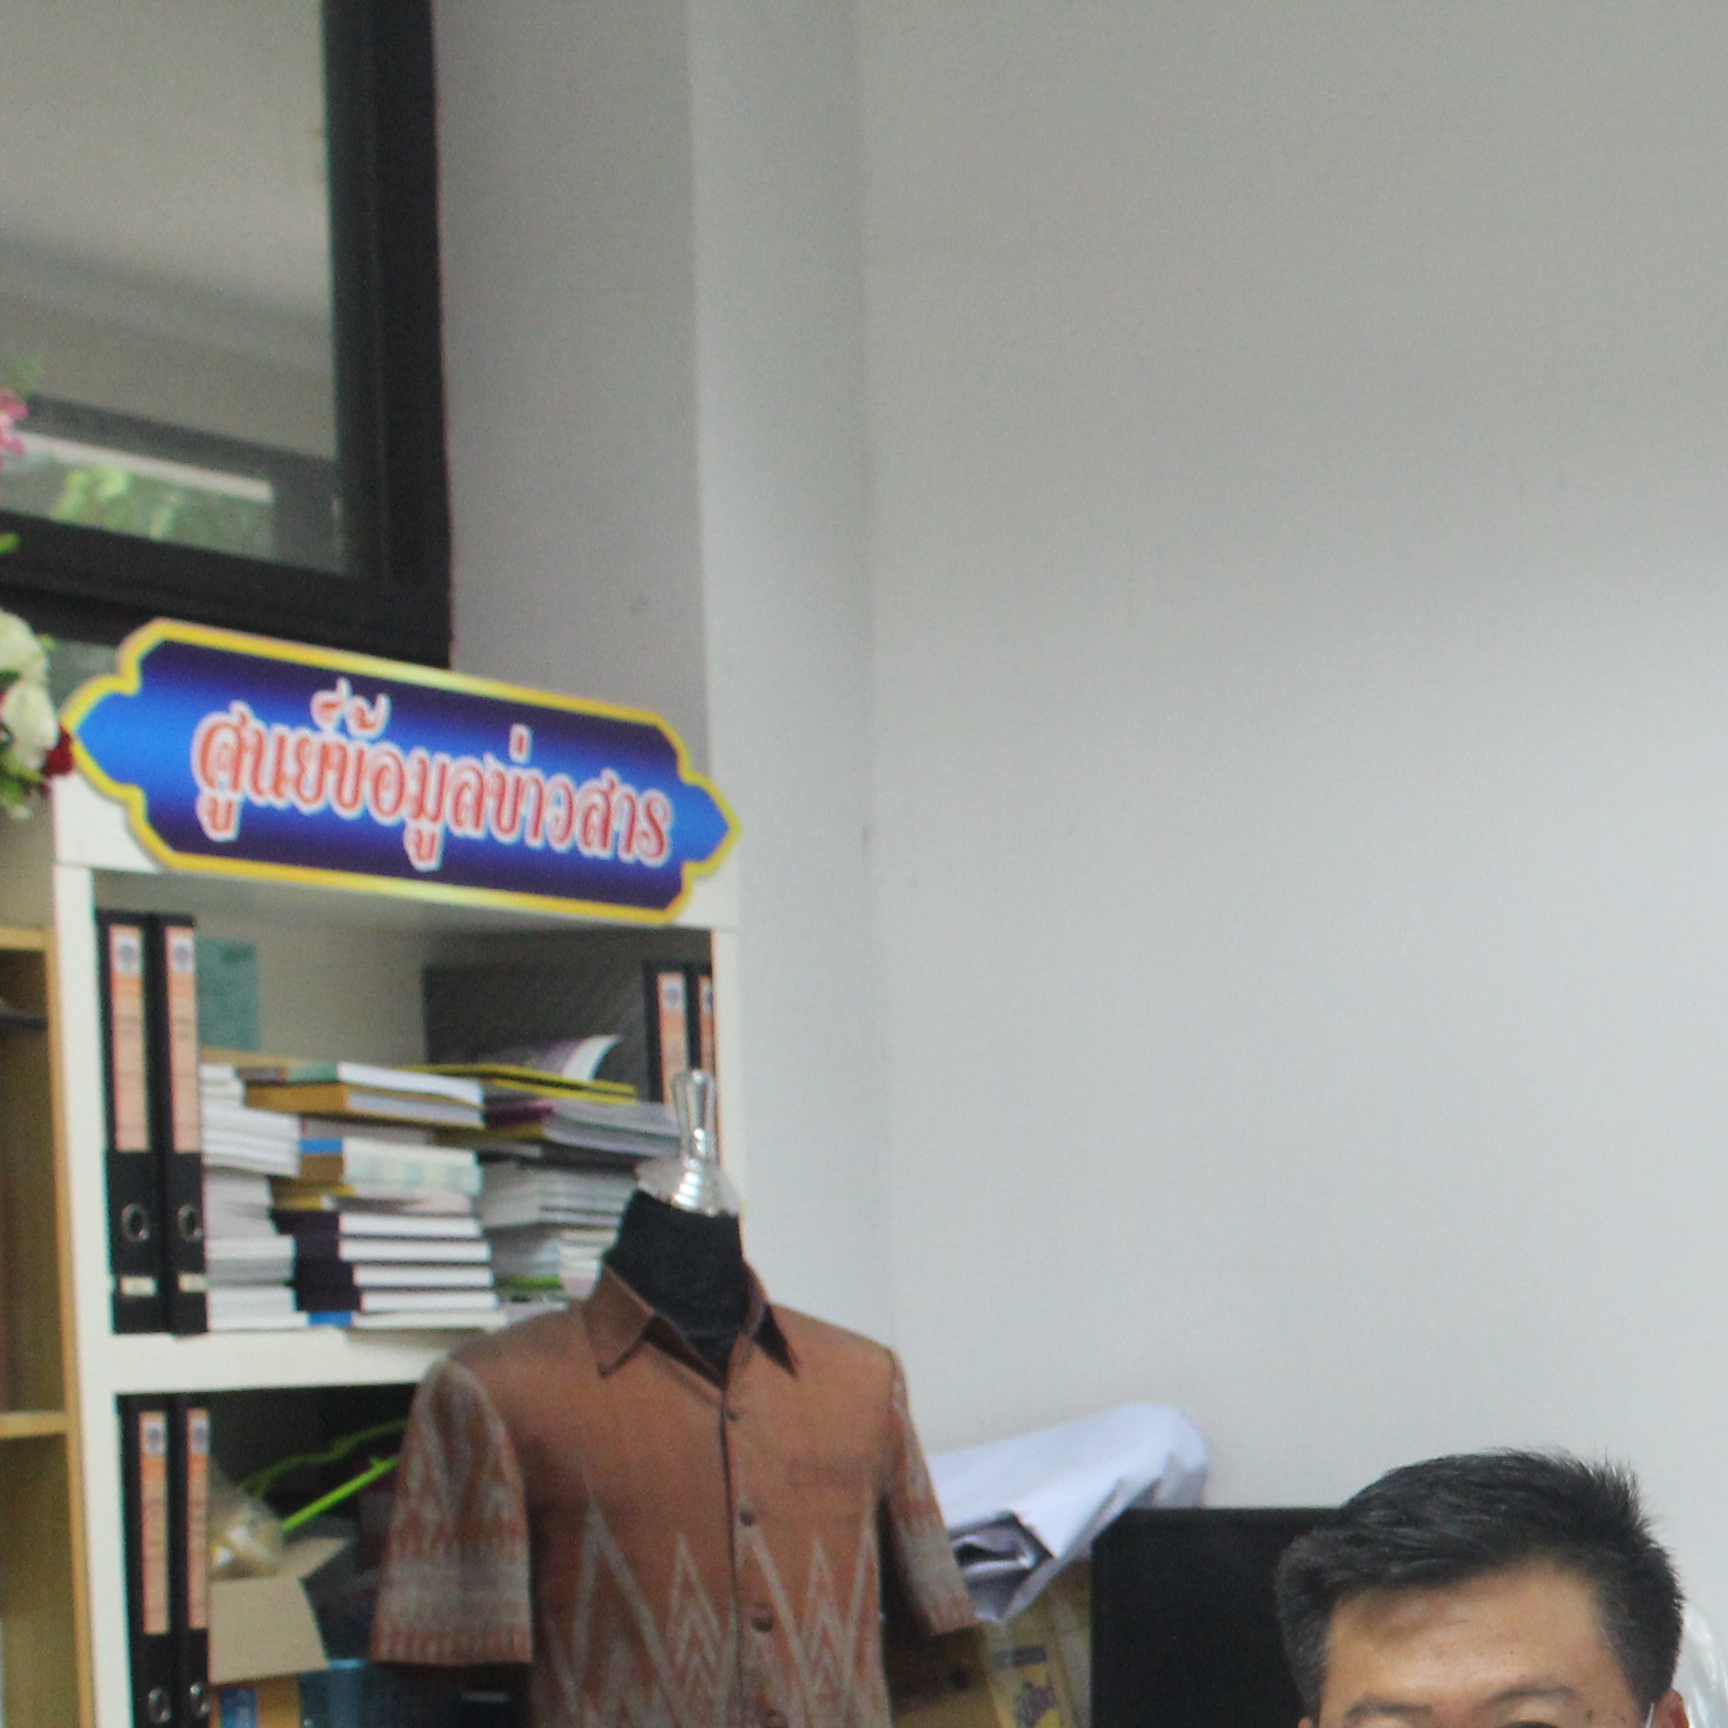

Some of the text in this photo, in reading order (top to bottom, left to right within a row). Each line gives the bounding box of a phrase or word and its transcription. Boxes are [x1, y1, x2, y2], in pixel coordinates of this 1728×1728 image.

[190, 676, 674, 872] ศูนย์ข้อมูลข่าวสาร
